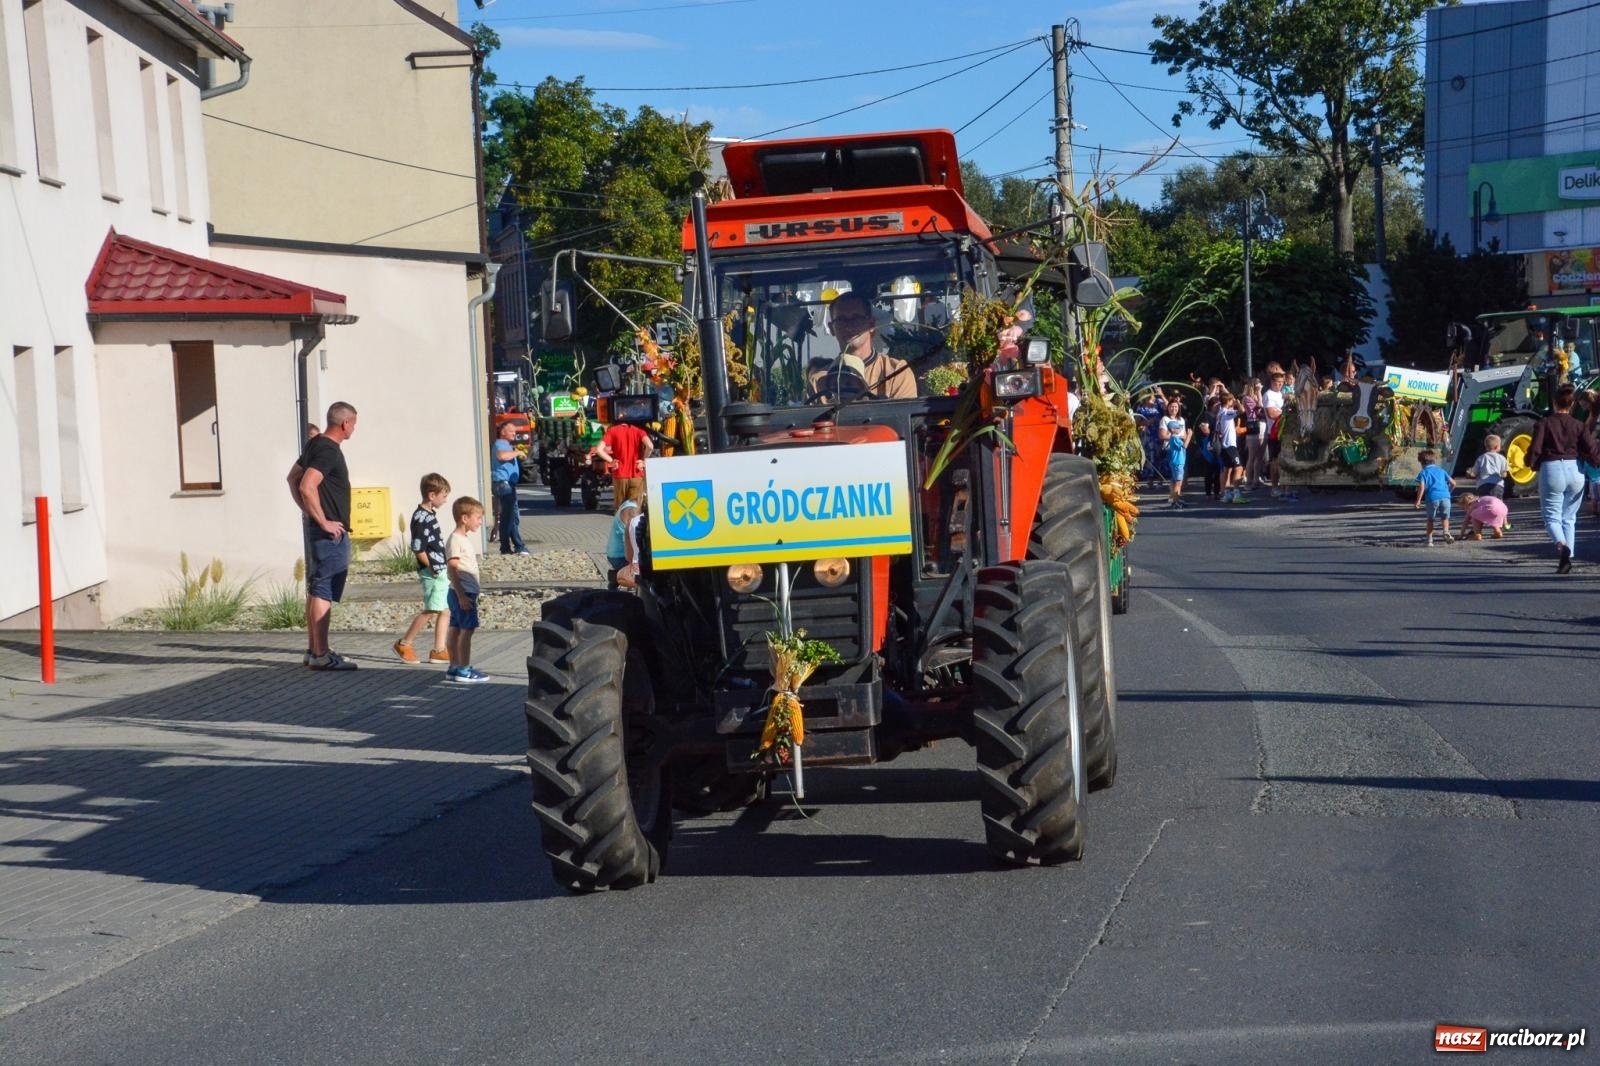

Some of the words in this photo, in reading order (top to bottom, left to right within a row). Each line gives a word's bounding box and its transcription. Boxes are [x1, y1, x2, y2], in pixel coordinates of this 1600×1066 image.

[757, 214, 893, 239] URSUS
[1407, 379, 1440, 393] KORNICE
[356, 502, 371, 510] GAZ
[727, 479, 893, 526] GRÓDCZANKI
